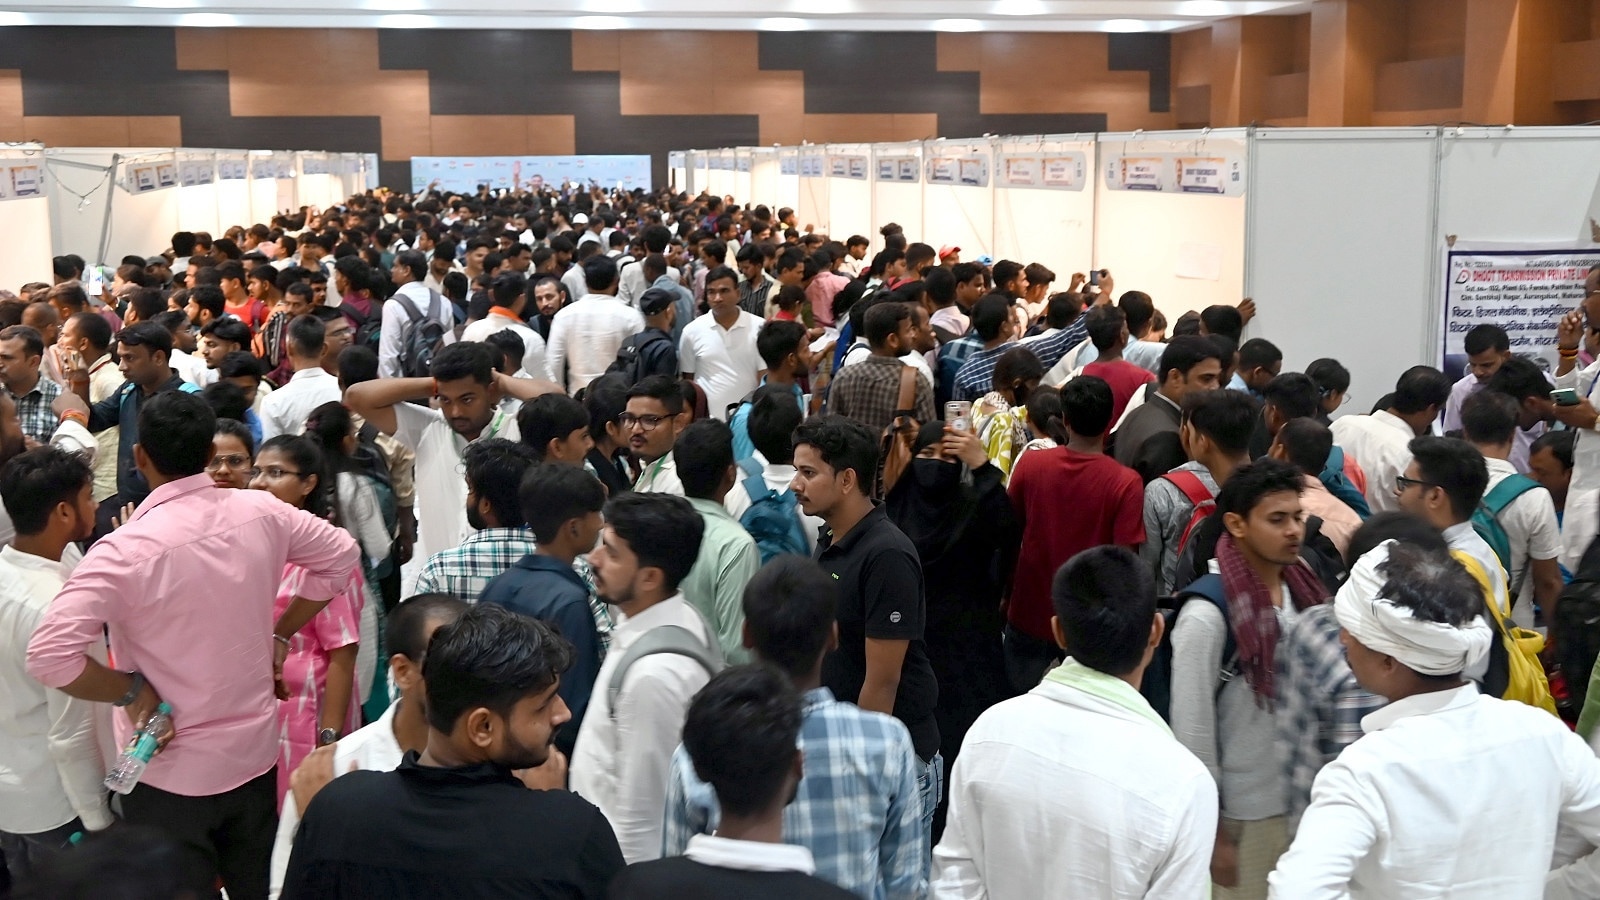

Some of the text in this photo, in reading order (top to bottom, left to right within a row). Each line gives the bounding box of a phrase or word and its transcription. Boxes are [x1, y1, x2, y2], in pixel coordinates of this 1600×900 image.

[1473, 268, 1589, 282] DHOOT TRANSMISSION PRIVATE LIM
